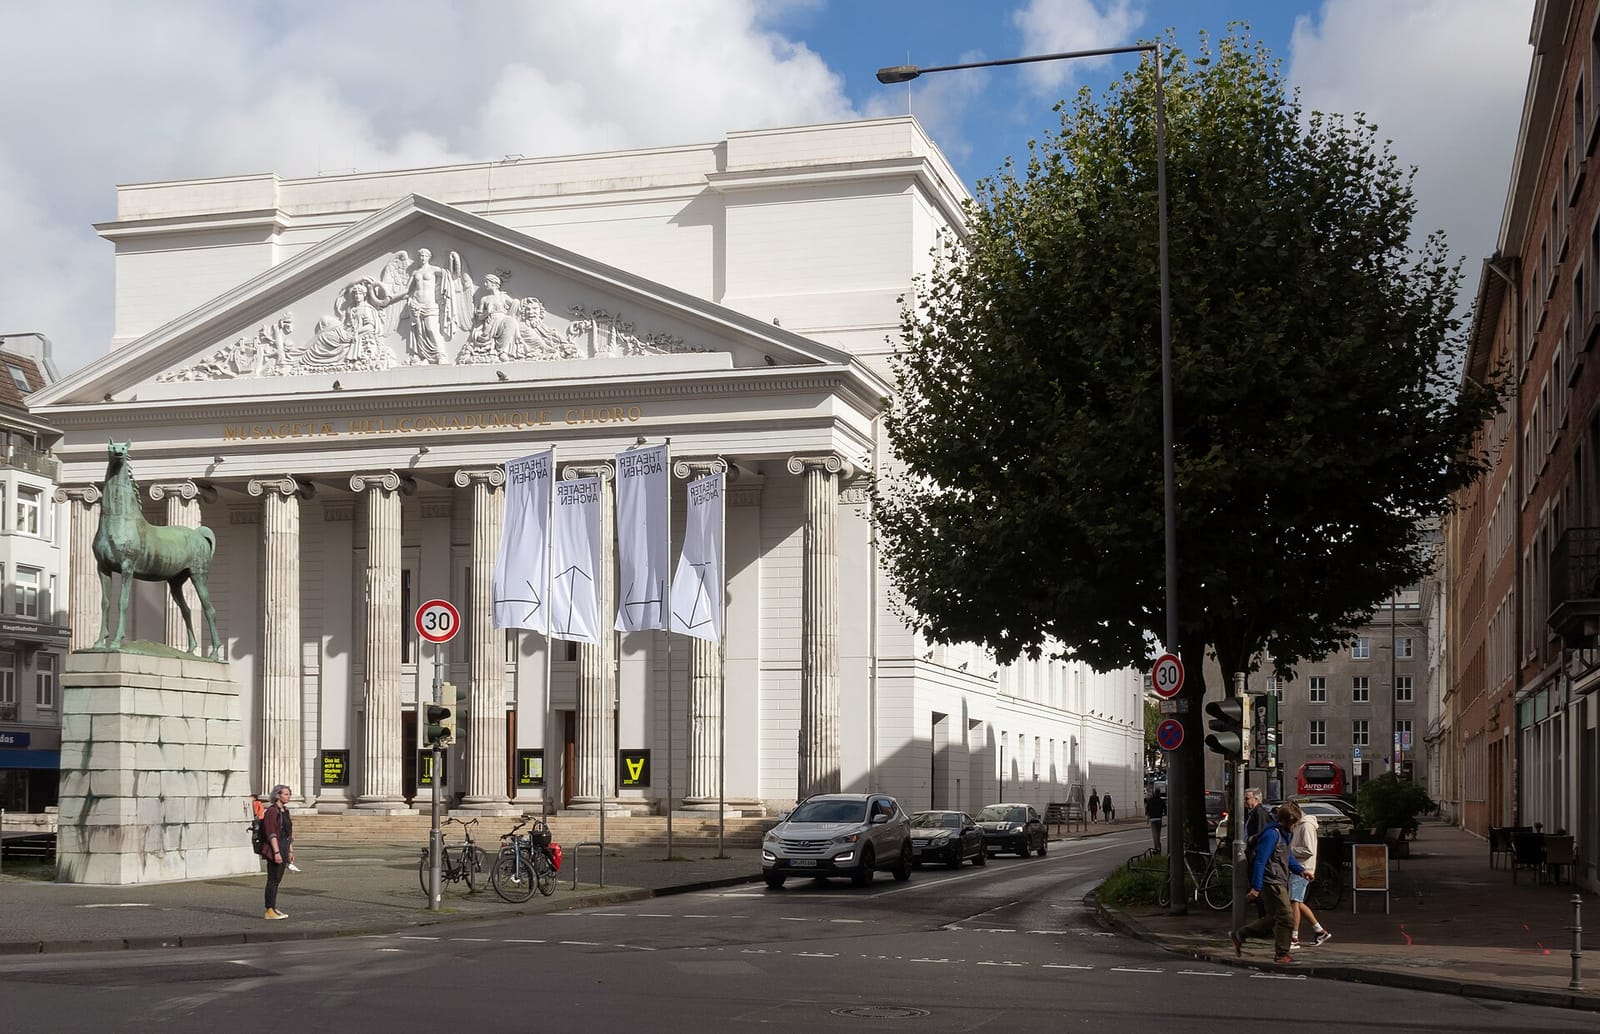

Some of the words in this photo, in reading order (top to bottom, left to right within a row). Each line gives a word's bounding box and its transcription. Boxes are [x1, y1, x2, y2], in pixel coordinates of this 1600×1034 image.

[349, 411, 552, 435] HELICONIADUMQUE
[565, 406, 642, 425] CHORO
[425, 612, 450, 631] 30
[1159, 665, 1177, 685] 30
